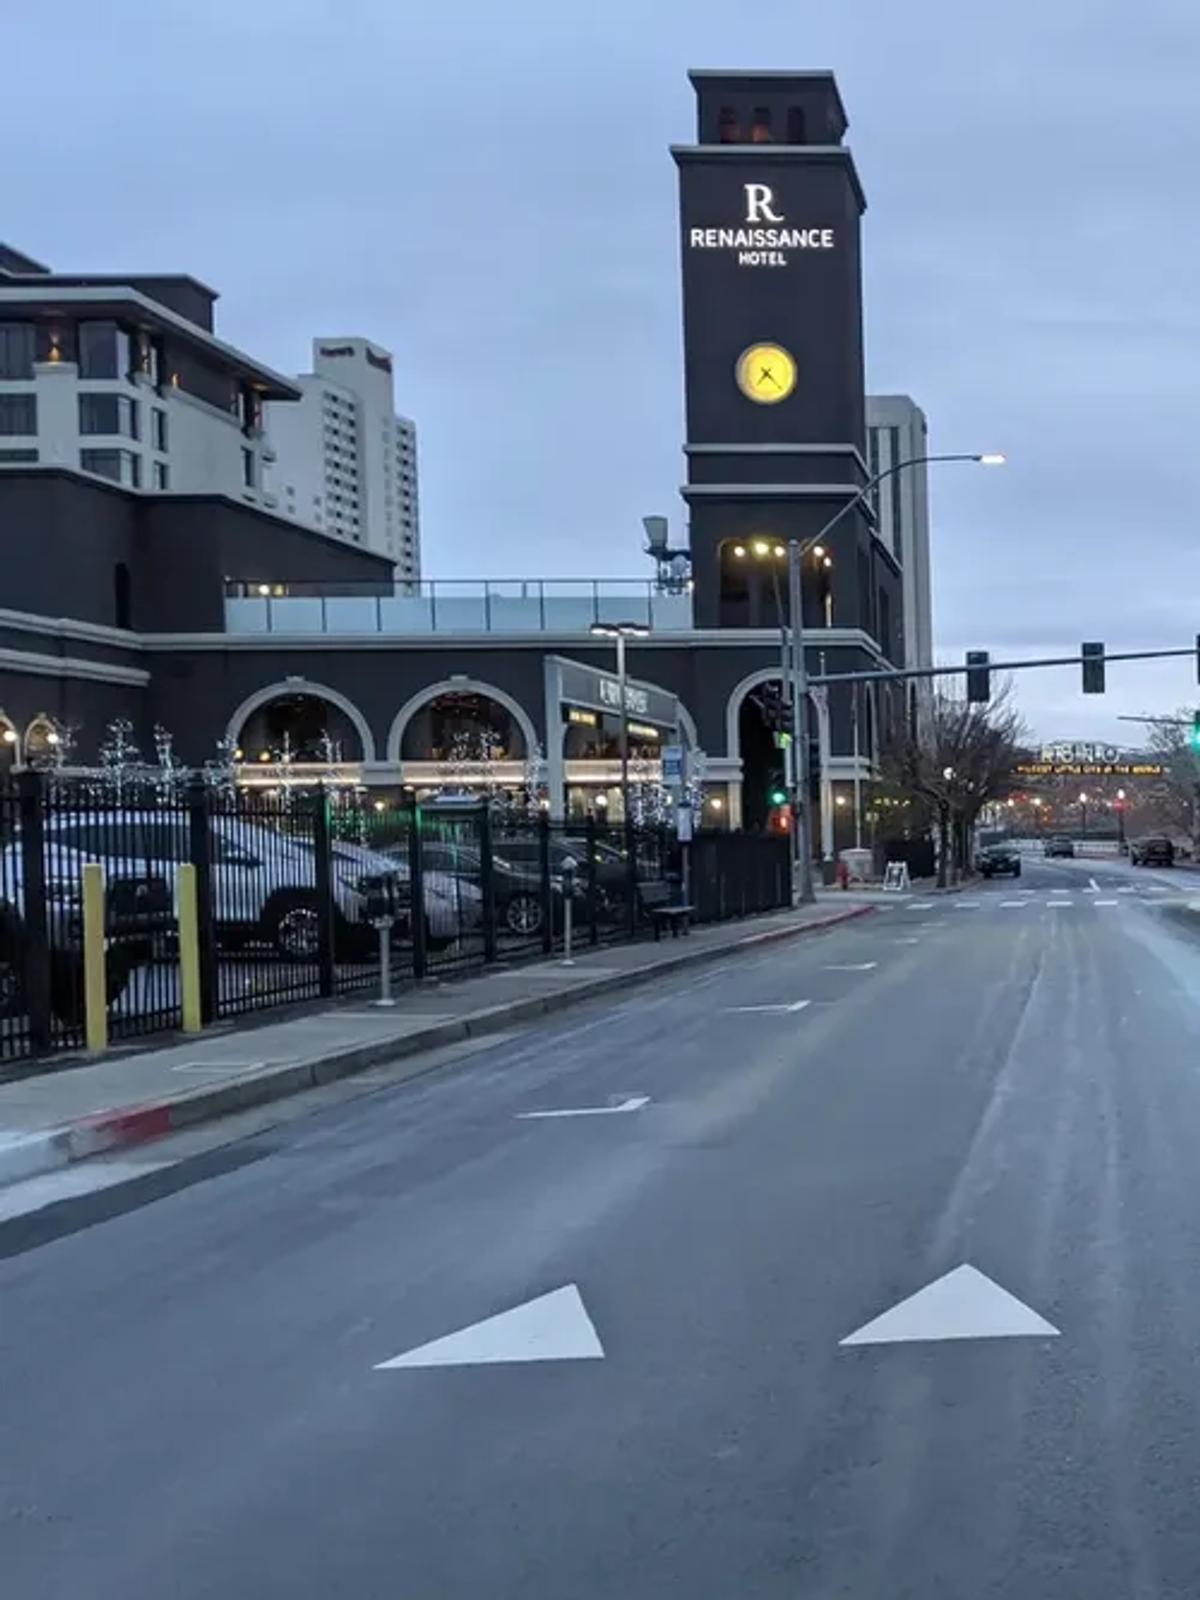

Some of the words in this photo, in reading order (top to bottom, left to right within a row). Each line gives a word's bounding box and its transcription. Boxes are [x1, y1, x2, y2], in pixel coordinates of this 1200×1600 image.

[744, 183, 785, 222] R
[690, 228, 834, 247] RENAISSANCE
[738, 251, 787, 265] HOTEL
